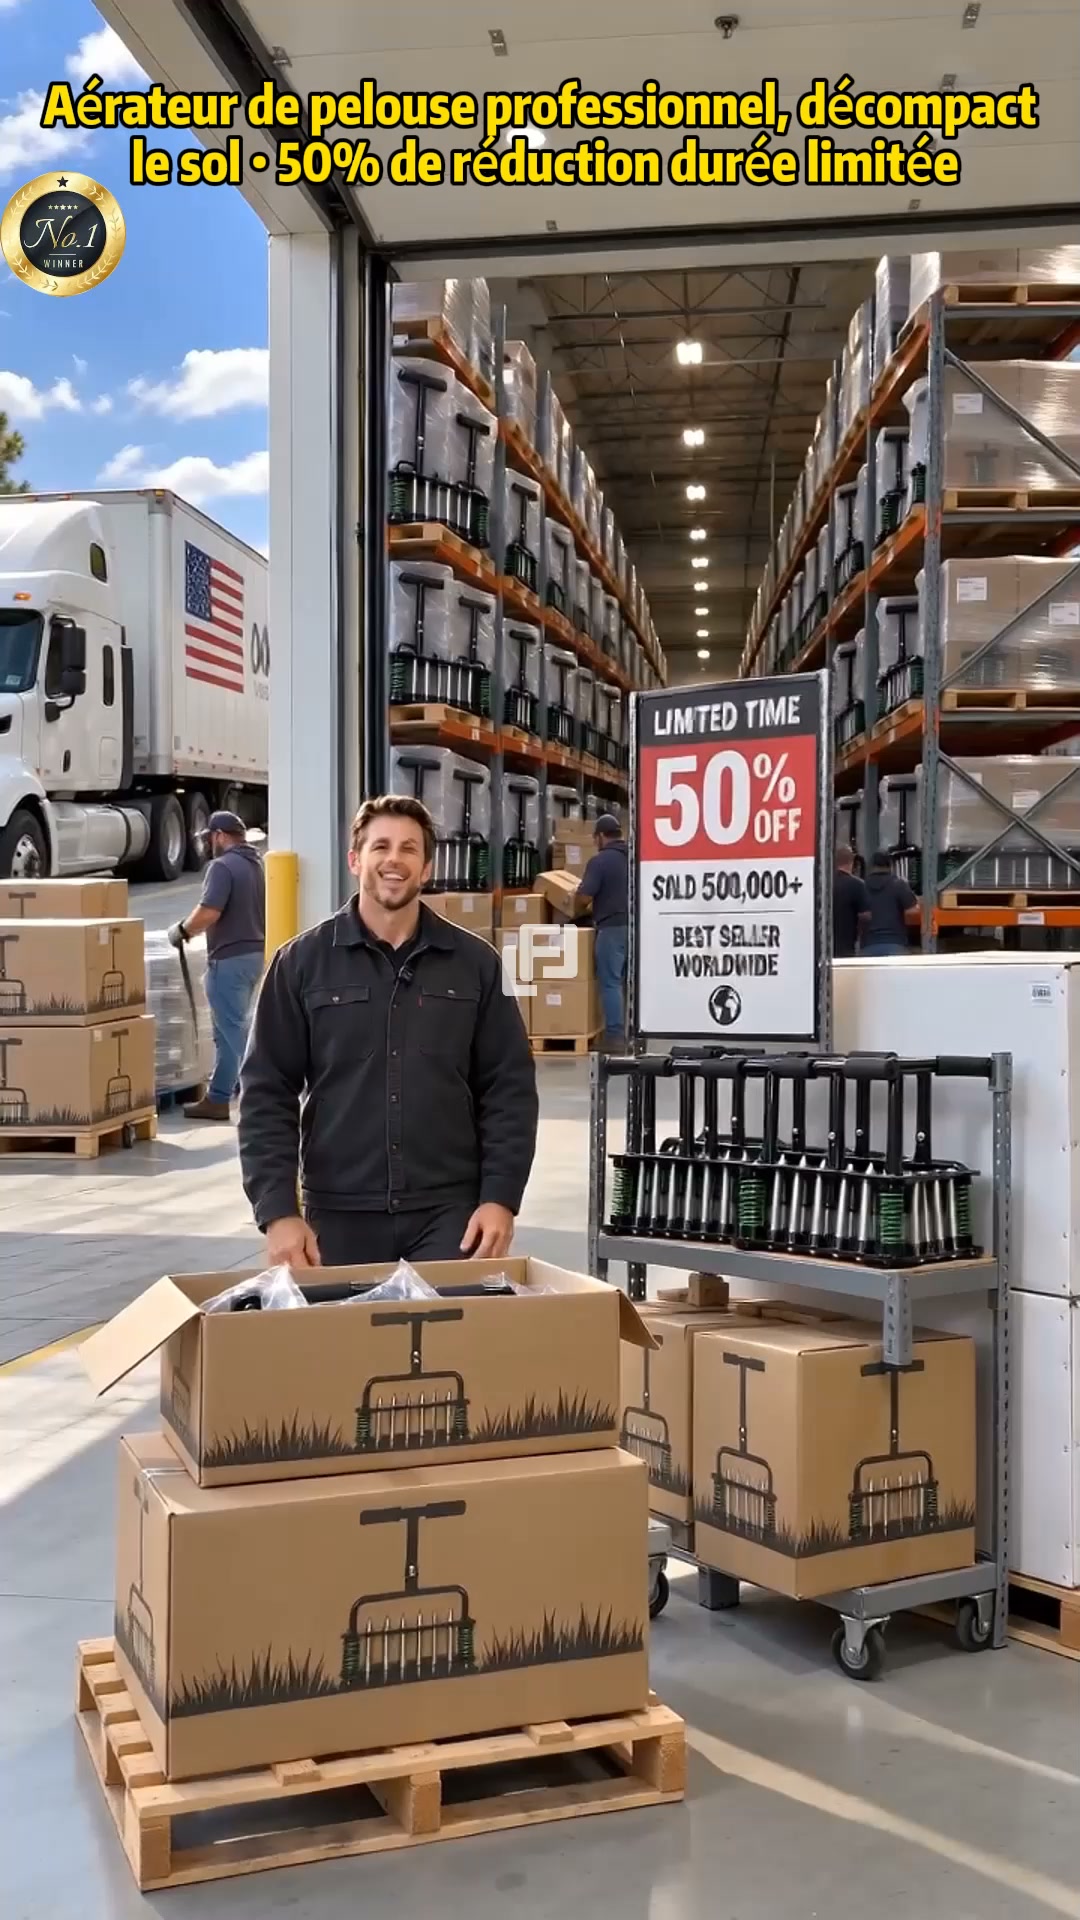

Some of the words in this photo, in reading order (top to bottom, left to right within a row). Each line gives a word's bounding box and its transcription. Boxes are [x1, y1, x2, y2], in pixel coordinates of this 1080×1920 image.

[745, 695, 801, 729] TIME
[654, 750, 796, 847] 50%
[754, 807, 802, 844] OFF
[701, 869, 803, 904] 500,000+
[672, 925, 715, 949] BEST
[672, 953, 779, 978] WORLDWIDE
